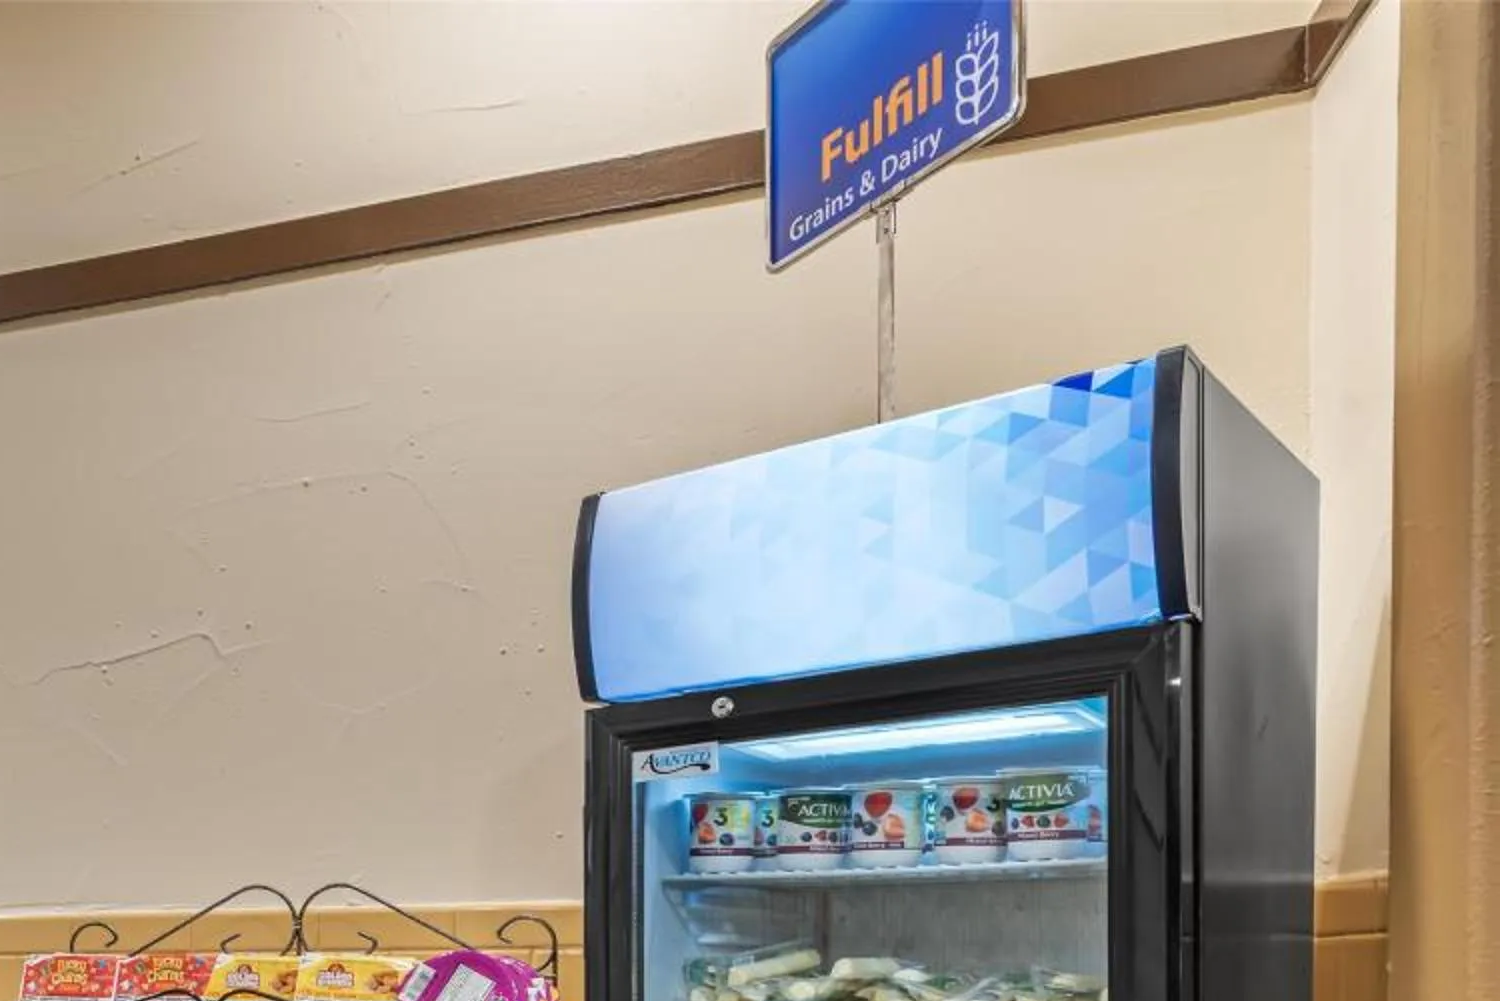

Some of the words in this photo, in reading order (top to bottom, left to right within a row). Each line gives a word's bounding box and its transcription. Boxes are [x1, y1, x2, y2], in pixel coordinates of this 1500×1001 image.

[820, 51, 945, 183] Fulfill
[789, 186, 854, 241] Grains
[859, 169, 876, 197] &
[881, 127, 944, 184] Dairy
